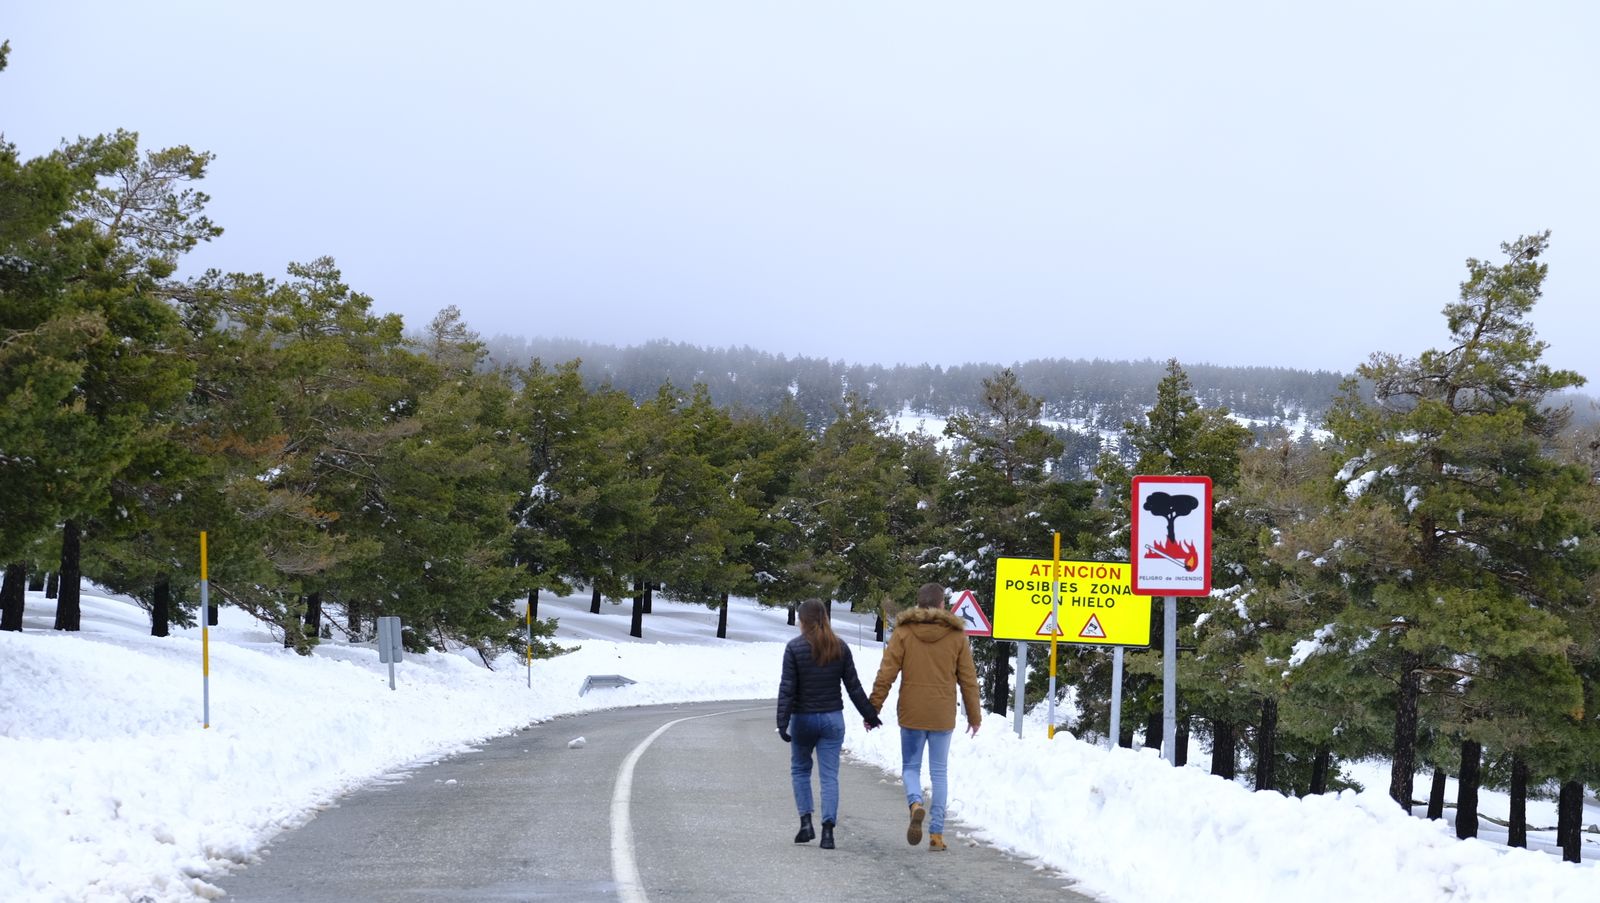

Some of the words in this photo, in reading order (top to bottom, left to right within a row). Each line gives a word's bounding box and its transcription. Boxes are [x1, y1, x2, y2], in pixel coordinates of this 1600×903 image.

[1005, 579, 1078, 593] POSIBES
[1031, 593, 1063, 606] CON
[1072, 596, 1115, 608] HIELO
